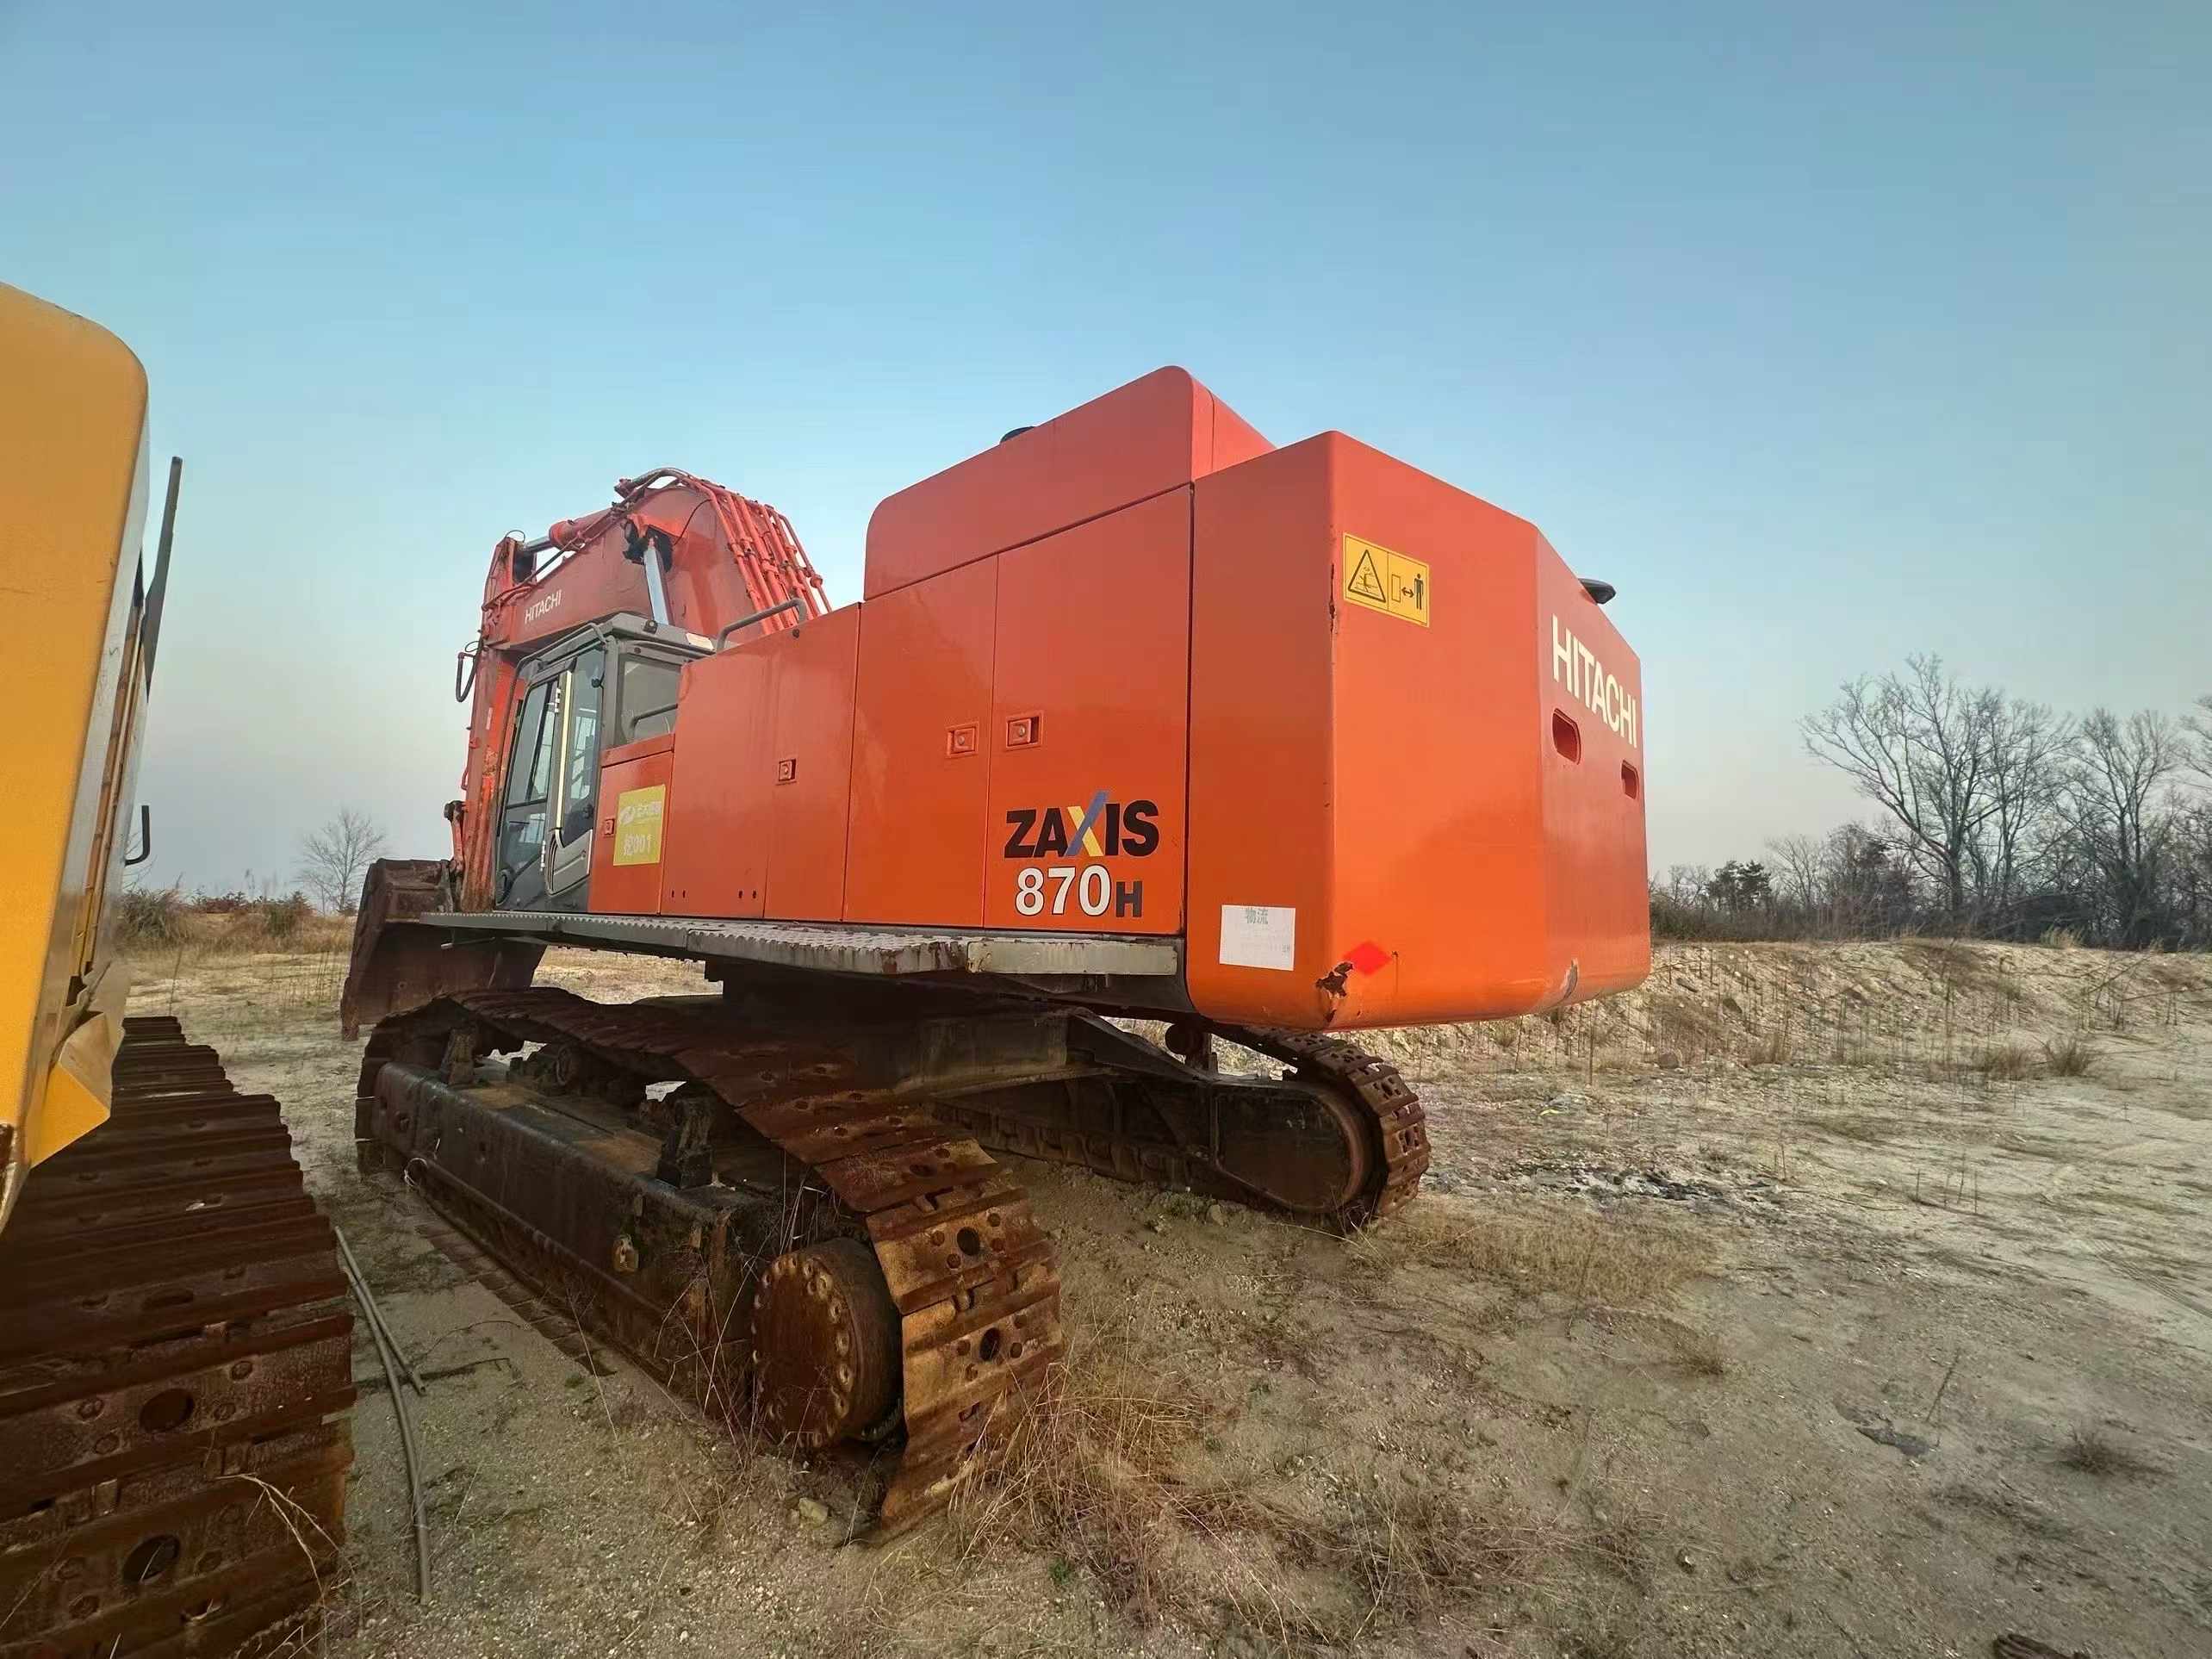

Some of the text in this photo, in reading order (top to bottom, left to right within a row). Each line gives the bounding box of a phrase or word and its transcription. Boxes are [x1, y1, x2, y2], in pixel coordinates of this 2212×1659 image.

[525, 589, 562, 624] HITACHI
[1552, 612, 1637, 749] HITACHI
[1004, 789, 1159, 858] ZAXIS
